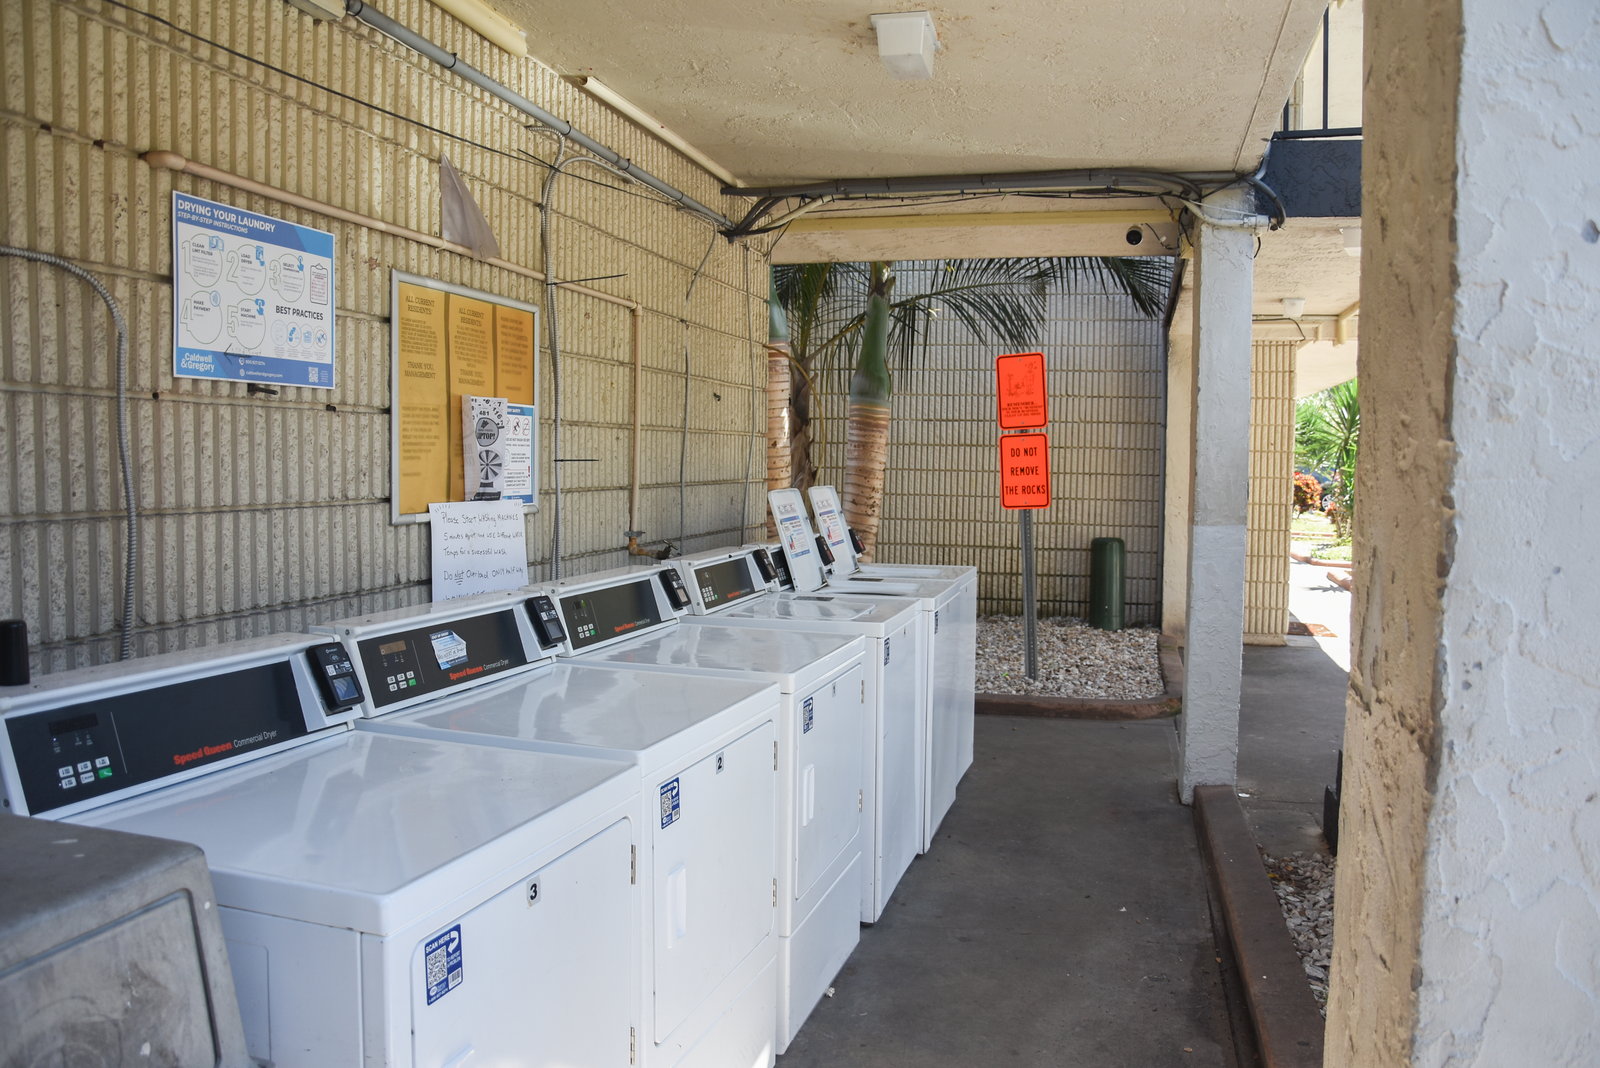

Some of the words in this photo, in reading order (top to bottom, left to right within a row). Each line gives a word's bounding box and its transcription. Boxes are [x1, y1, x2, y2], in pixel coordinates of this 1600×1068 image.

[178, 200, 211, 216] DRYING
[213, 209, 236, 223] YOUR
[238, 216, 275, 232] LAUNDRY
[178, 211, 213, 224] STEP-BY-STEP
[213, 220, 248, 233] INSTRUCTIONS
[276, 305, 291, 315] BEST
[292, 308, 323, 320] PRACTICES
[185, 353, 212, 362] Caldwell
[1010, 448, 1021, 457] DO
[1023, 447, 1038, 456] NOT
[1010, 466, 1039, 476] REMOVE
[1005, 486, 1019, 495] THE
[1022, 485, 1046, 495] ROCKS
[173, 748, 203, 765] Speed
[204, 742, 233, 756] Queen
[233, 733, 263, 748] Commercial
[263, 730, 277, 740] Dryer
[717, 757, 722, 770] 2
[530, 883, 537, 900] 3
[426, 940, 439, 953] SCAN
